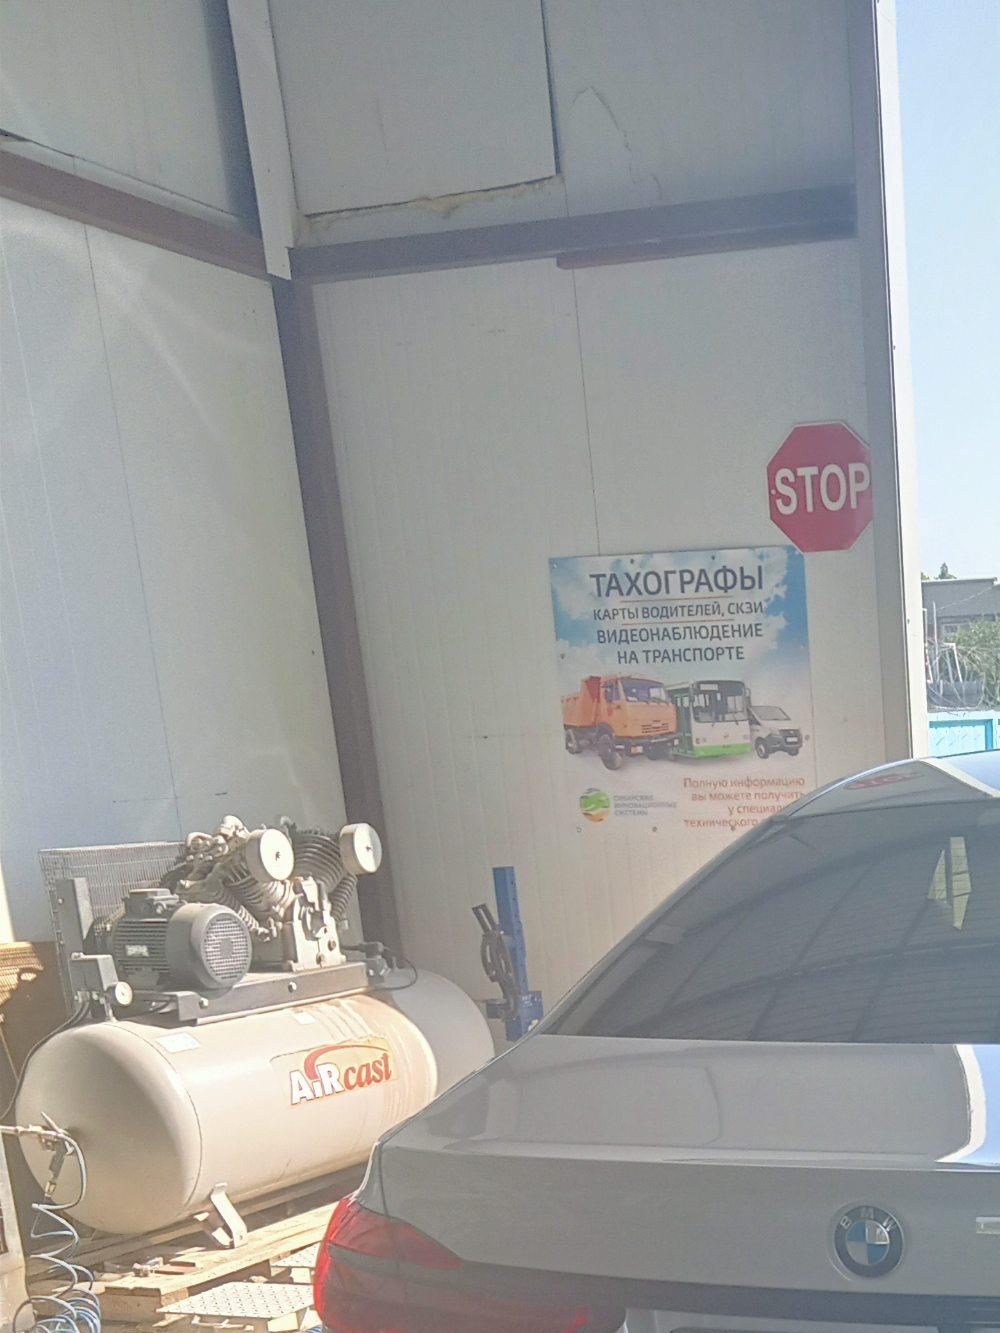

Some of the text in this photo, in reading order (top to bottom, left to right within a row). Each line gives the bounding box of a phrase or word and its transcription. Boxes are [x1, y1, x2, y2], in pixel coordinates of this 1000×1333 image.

[775, 462, 871, 515] STOP
[589, 565, 764, 597] ТАХОГРАФЫ
[593, 601, 764, 621] КАРТЫ ВОДИТЕЛЕЙ, СКЗИ
[597, 623, 763, 645] ВИДЕОНАБЛЮДЕНИЕ
[617, 646, 745, 664] НА ТРАНСПОРТЕ
[683, 776, 805, 790] Полную информацию
[709, 791, 752, 801] можете
[684, 818, 759, 829] технического
